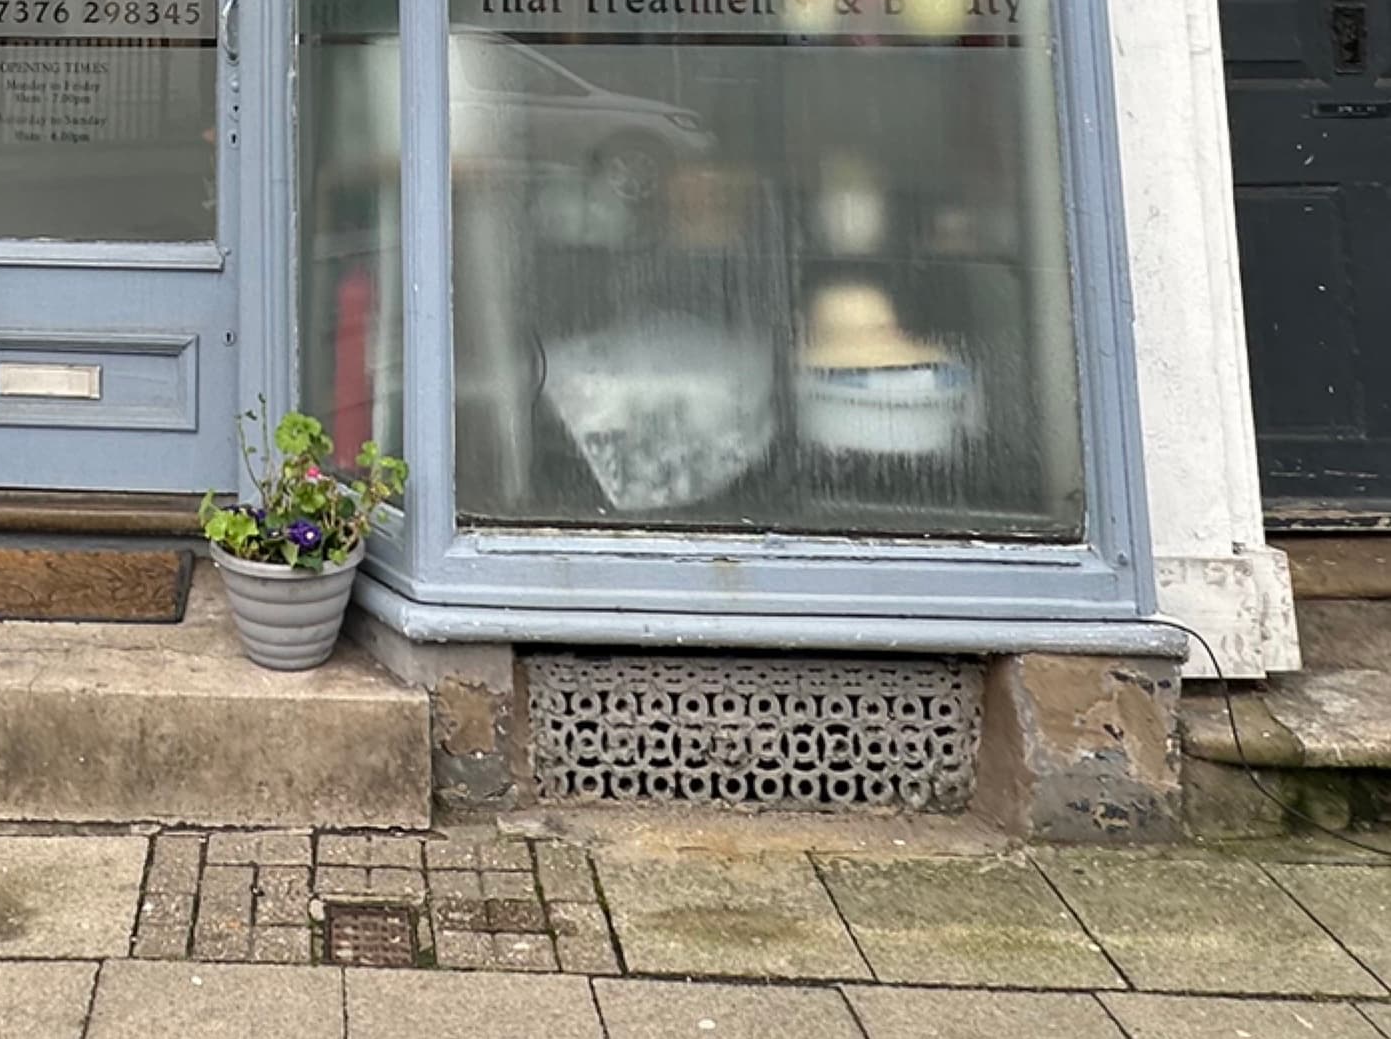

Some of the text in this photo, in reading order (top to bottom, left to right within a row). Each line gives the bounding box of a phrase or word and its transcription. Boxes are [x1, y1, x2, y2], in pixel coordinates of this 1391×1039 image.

[82, 0, 202, 26] 298345
[0, 62, 108, 73] OPENING TIMES
